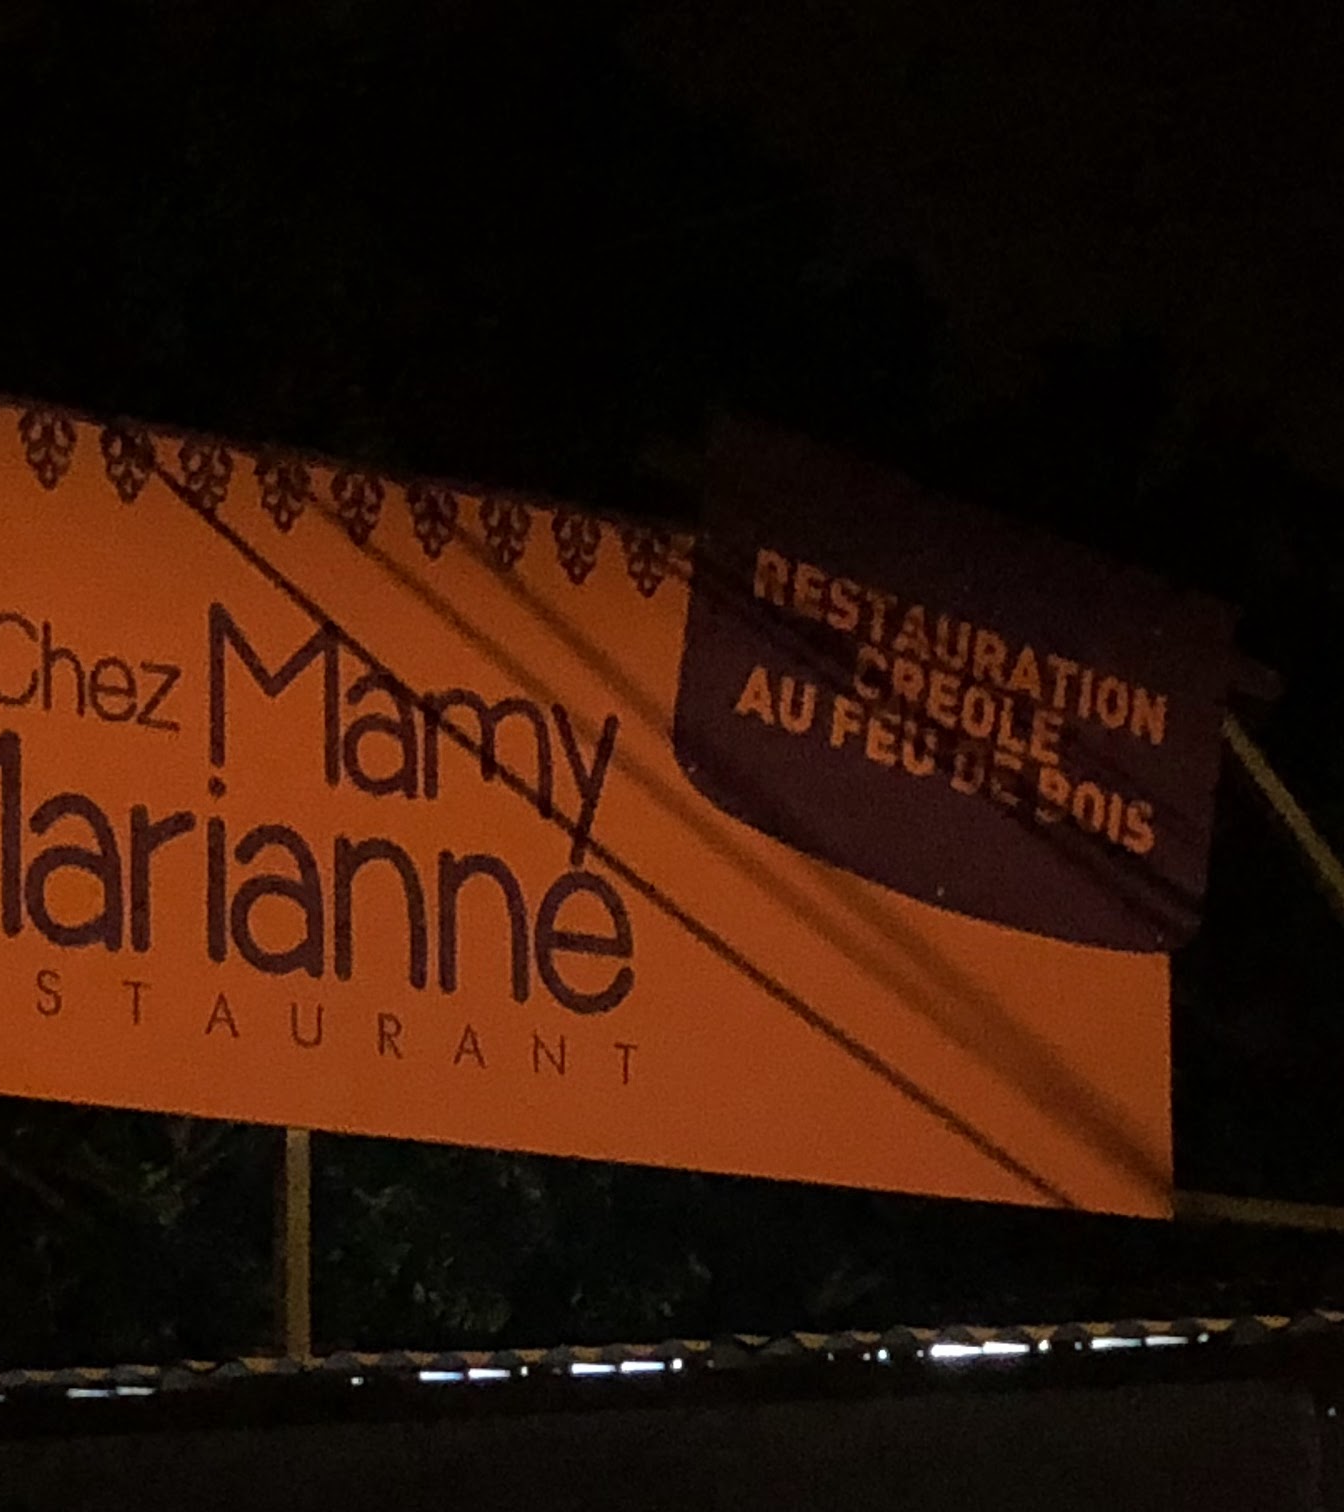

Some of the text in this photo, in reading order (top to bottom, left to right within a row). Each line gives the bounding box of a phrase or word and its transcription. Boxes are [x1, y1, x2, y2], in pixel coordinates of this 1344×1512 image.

[208, 600, 620, 867] Mamy
[752, 545, 1169, 747] RESTAURATION
[854, 643, 1067, 768] CREOLE
[731, 664, 817, 736] AU
[828, 692, 939, 779] FEU
[1034, 763, 1157, 857] BOIS
